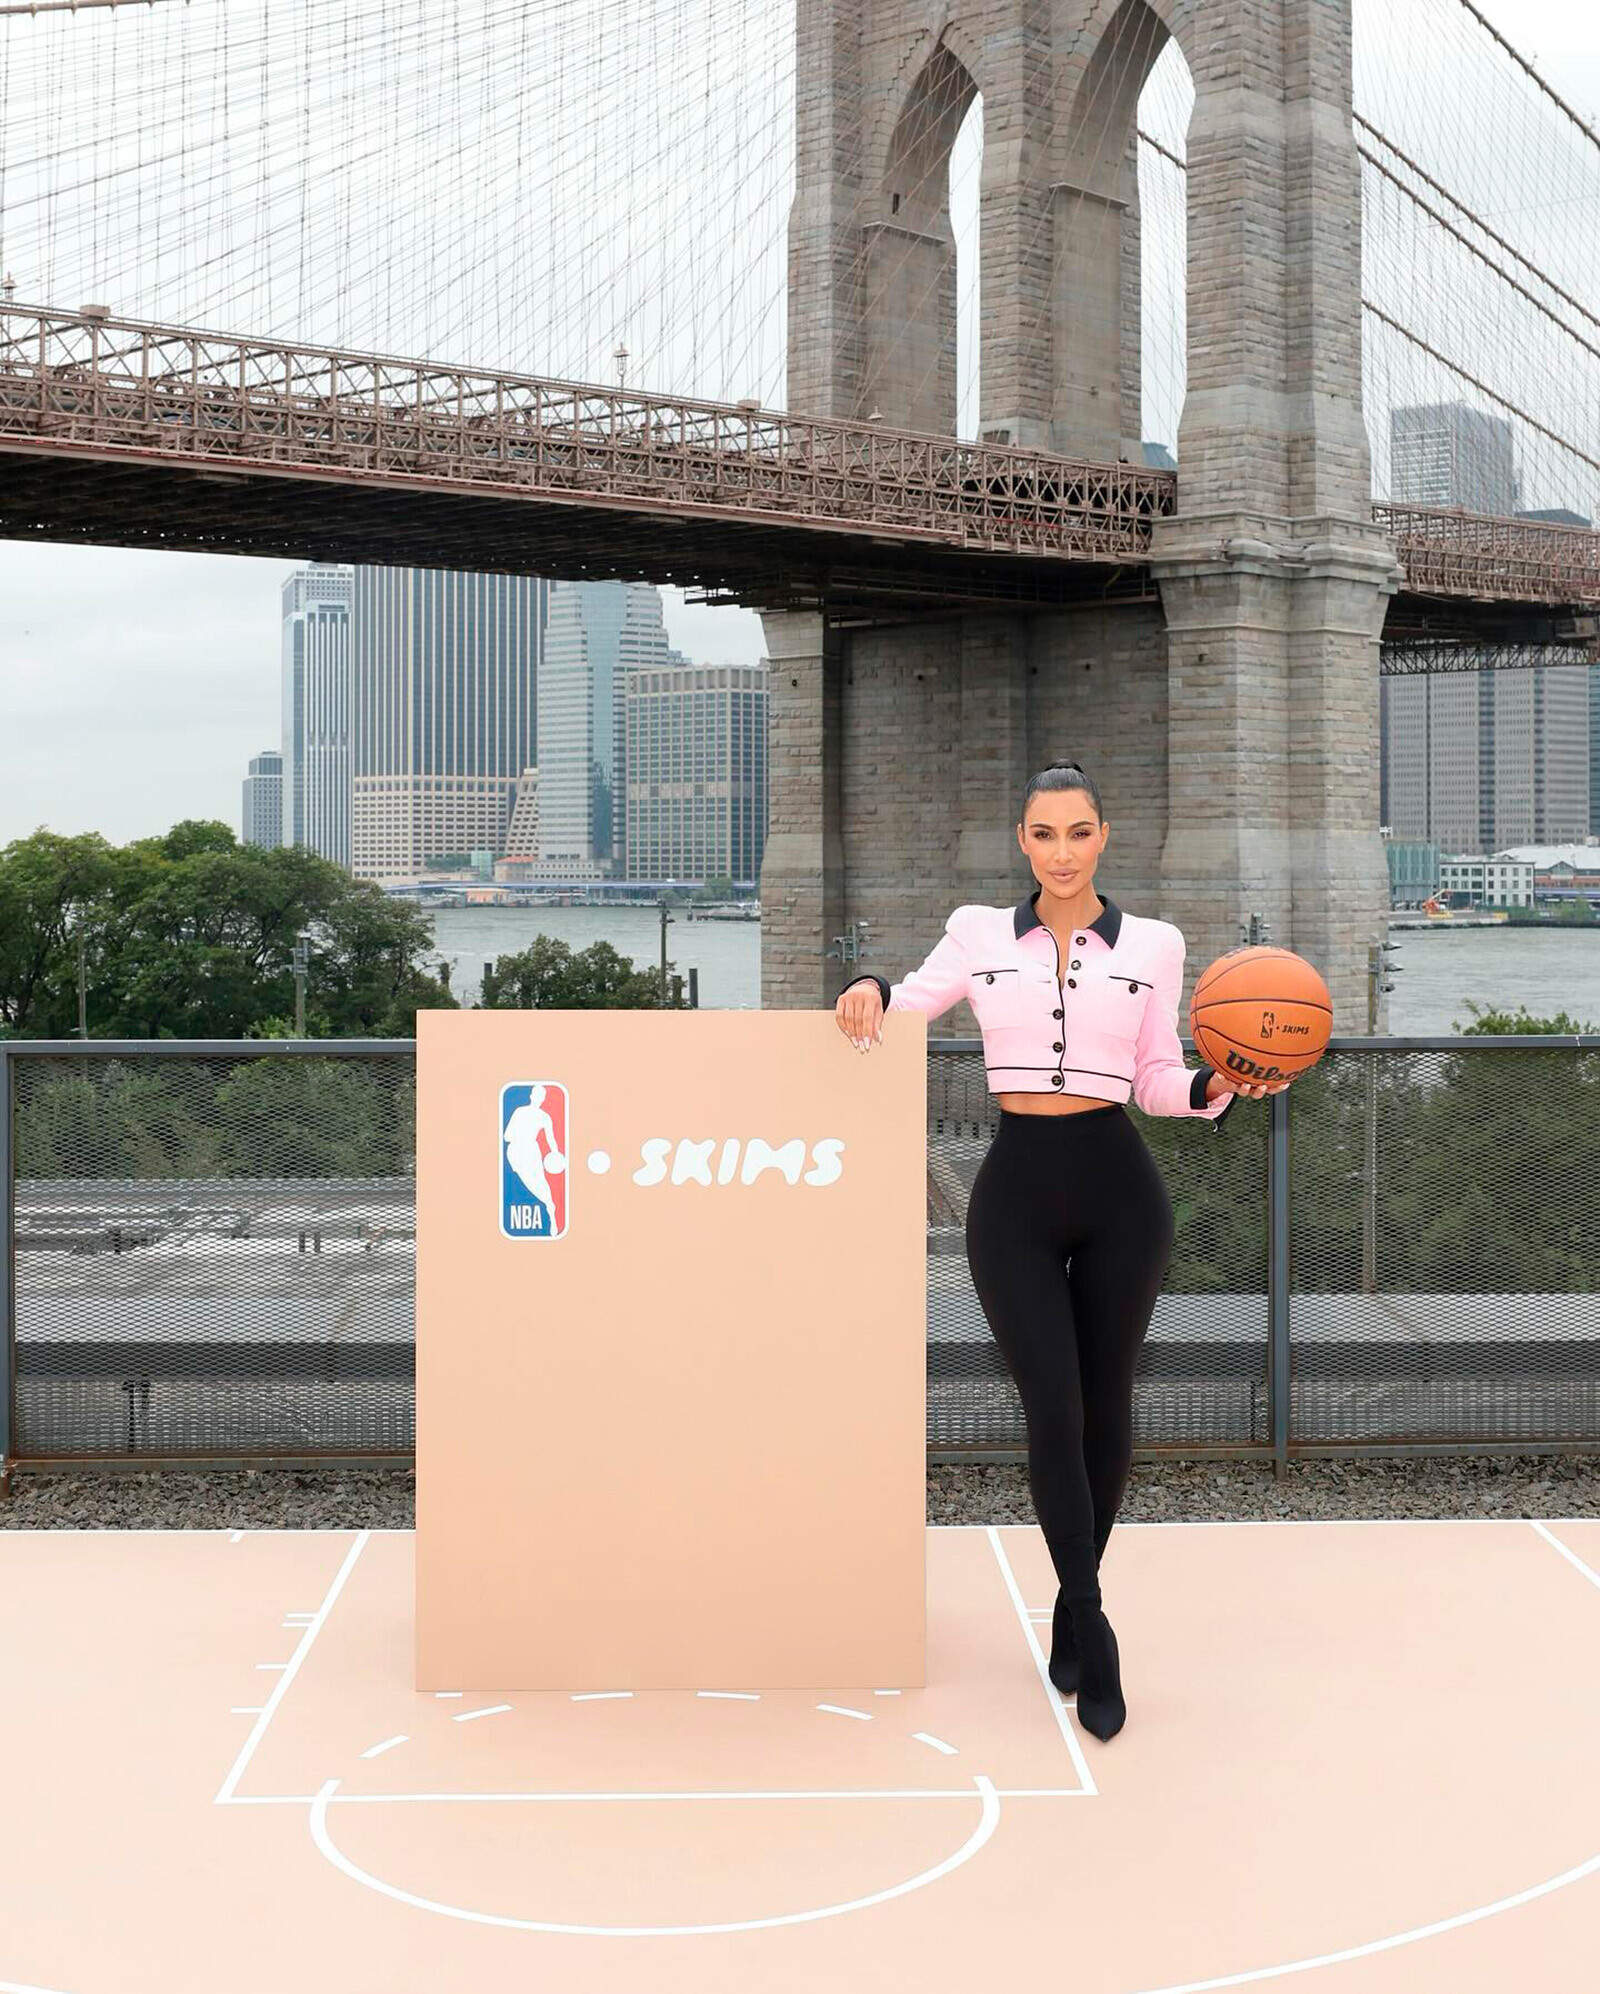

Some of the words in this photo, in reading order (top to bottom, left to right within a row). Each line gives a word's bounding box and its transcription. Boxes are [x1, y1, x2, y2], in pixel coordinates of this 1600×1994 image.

[1282, 1025, 1309, 1035] SKIMS
[632, 1138, 845, 1186] SKIMS
[510, 1205, 542, 1229] NBA
